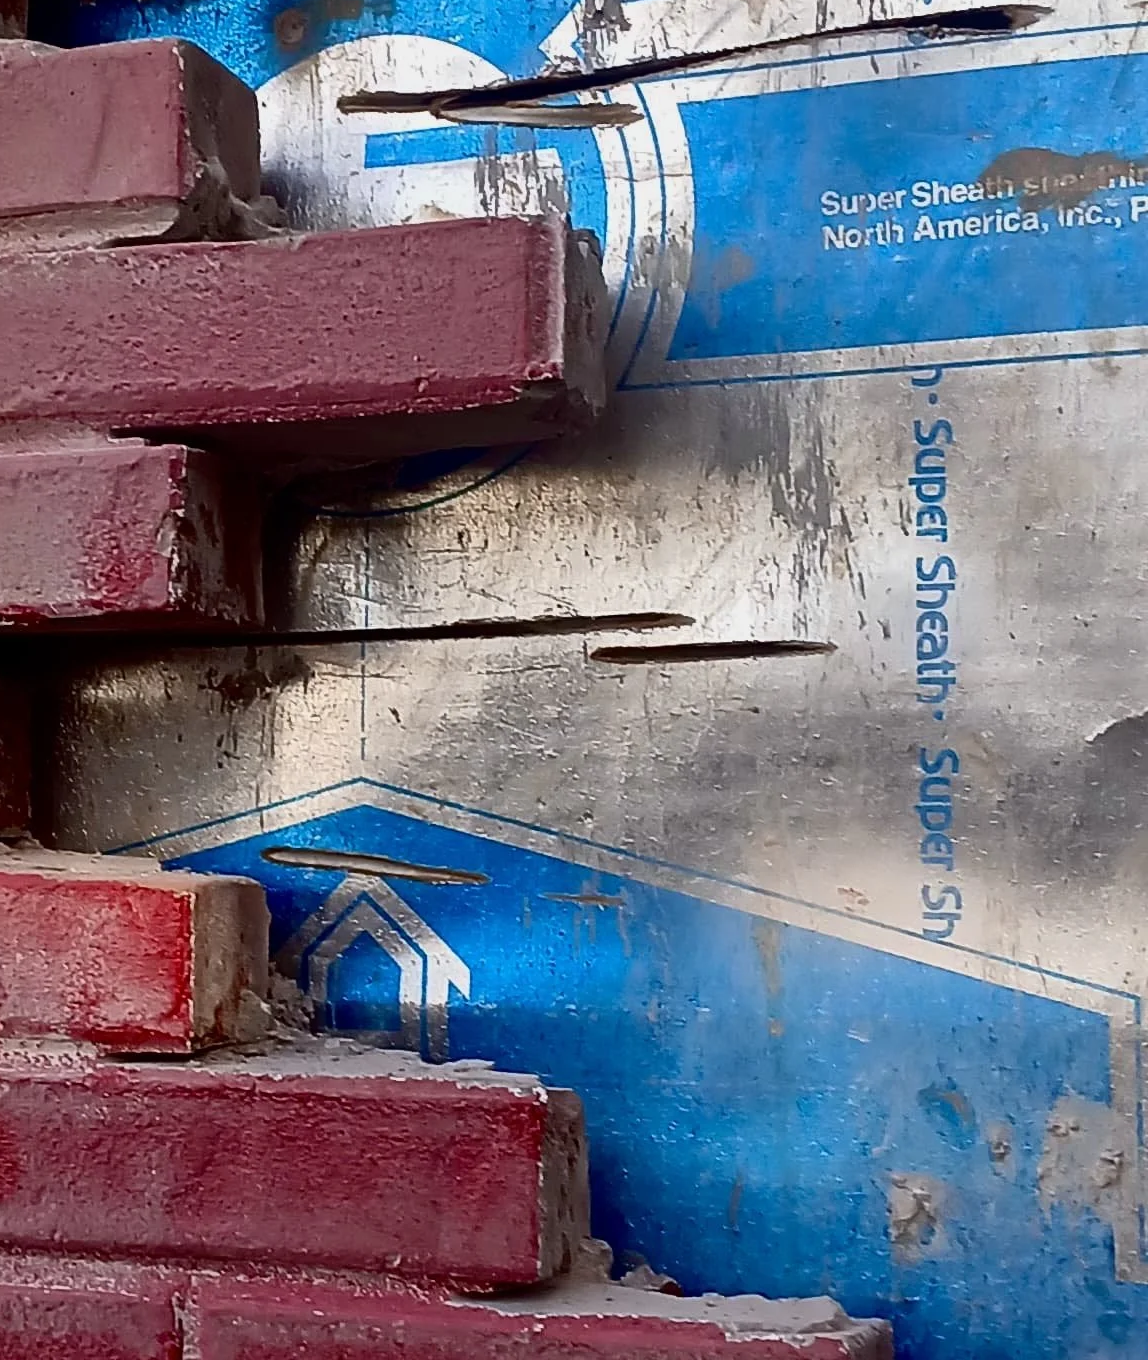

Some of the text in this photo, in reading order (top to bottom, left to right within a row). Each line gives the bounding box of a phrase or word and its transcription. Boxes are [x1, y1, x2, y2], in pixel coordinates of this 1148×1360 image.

[820, 189, 906, 217] Super
[911, 175, 1014, 209] Sheath
[823, 216, 904, 250] North
[913, 208, 1050, 242] America,
[908, 419, 955, 542] Super
[912, 747, 960, 872] Super
